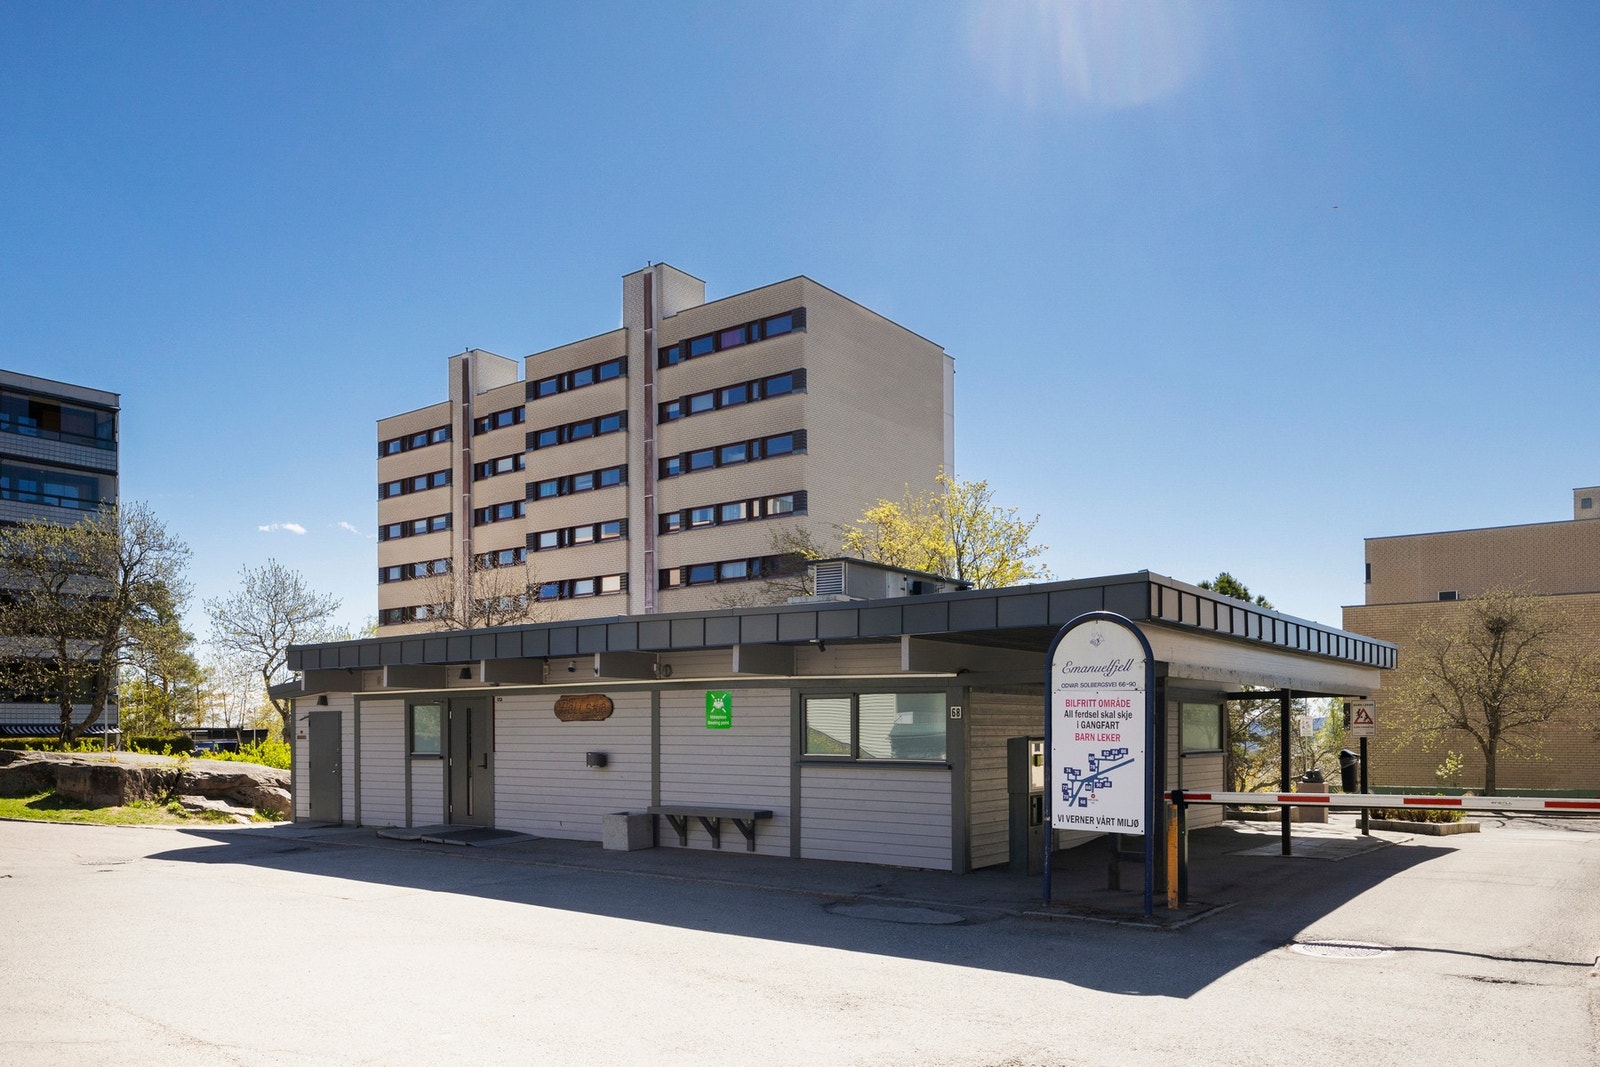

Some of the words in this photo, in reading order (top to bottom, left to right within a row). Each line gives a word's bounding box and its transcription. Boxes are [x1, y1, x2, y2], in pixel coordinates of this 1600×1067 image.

[1062, 659, 1134, 677] Emanuelfjell
[1065, 699, 1096, 708] BILFRITT
[1098, 697, 1131, 708] OMRÅDE
[952, 708, 960, 718] 68
[1064, 710, 1073, 718] All
[1074, 710, 1099, 718] ferdsel
[1100, 710, 1116, 719] skal
[1117, 711, 1133, 720] skje
[1076, 720, 1080, 729] i
[1080, 720, 1120, 730] GANGFART
[1074, 732, 1095, 741] BARN
[1097, 733, 1120, 742] LEKER
[1058, 814, 1064, 822] VI
[1066, 815, 1094, 824] VERNER
[1096, 815, 1116, 826] VÅRT
[1116, 818, 1140, 828] MILJØ
